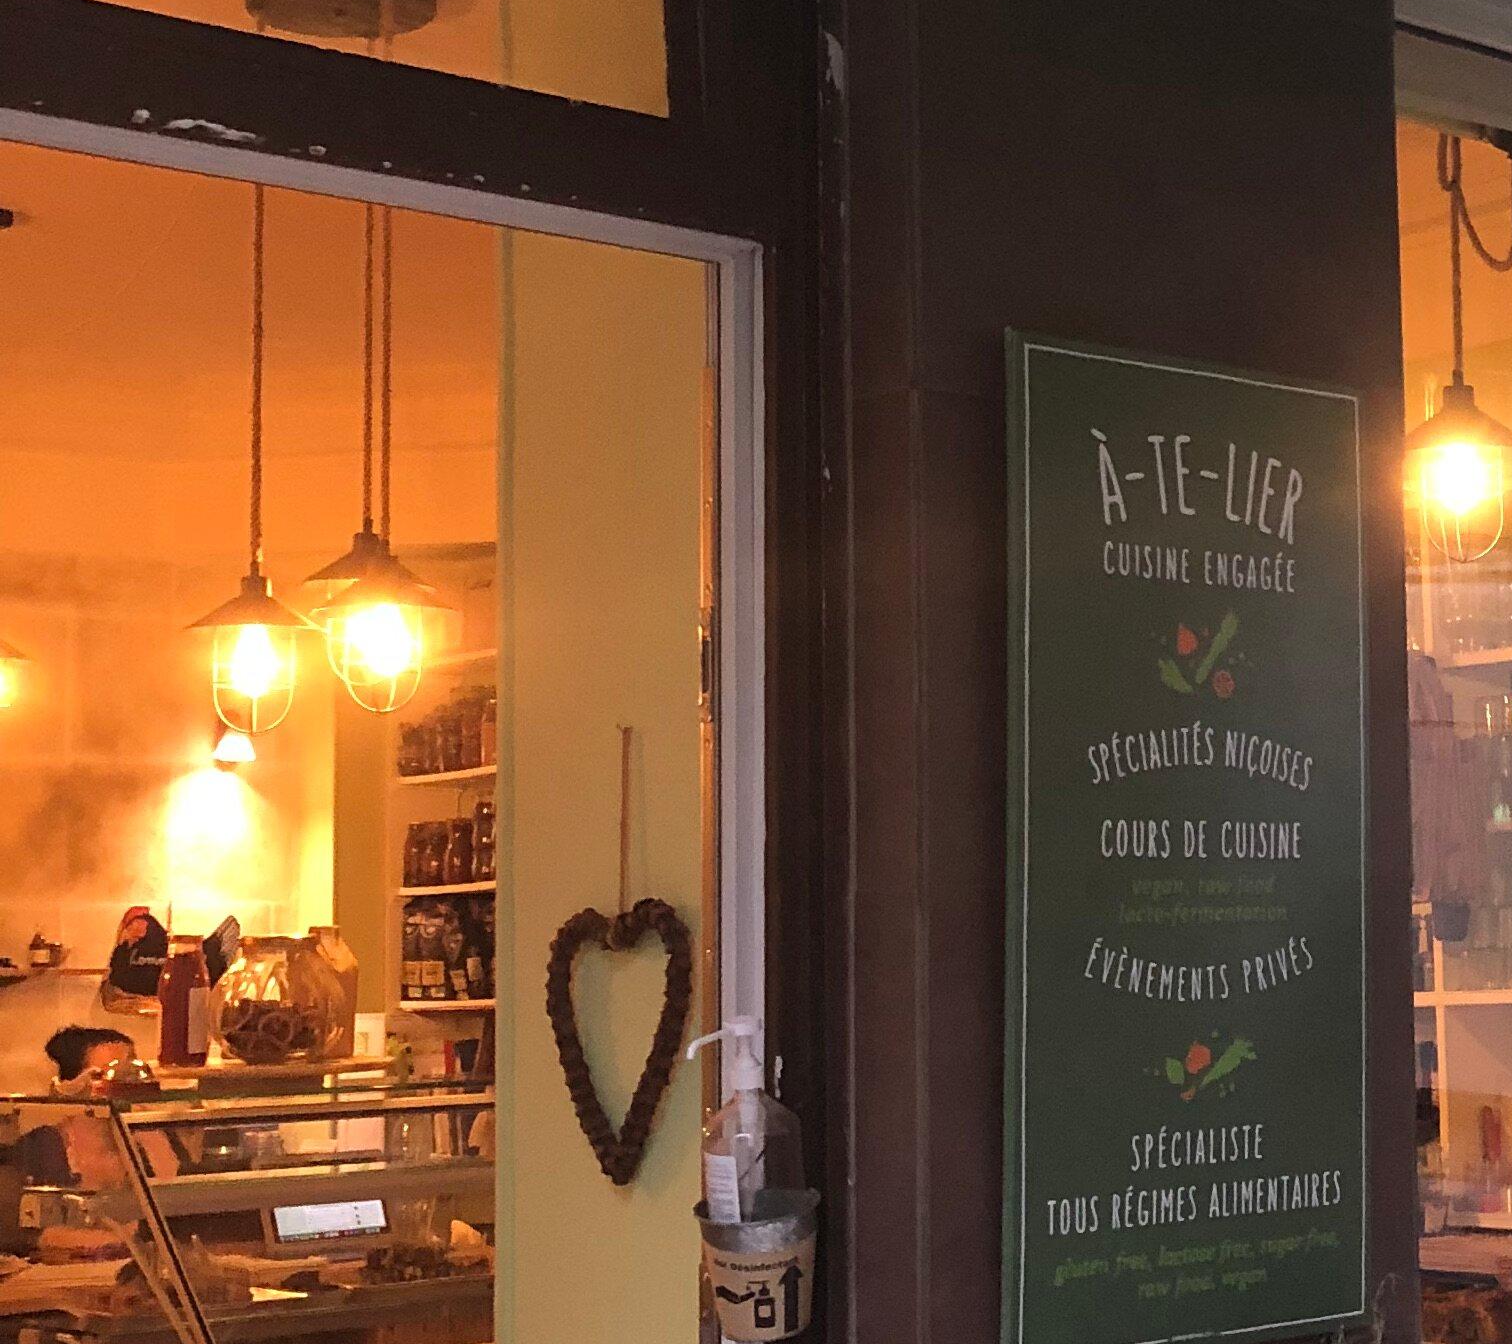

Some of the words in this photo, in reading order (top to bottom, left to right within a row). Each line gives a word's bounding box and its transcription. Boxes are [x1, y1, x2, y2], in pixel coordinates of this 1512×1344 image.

[1090, 428, 1304, 545] À-TE-LIER
[1103, 540, 1191, 584] CUISINE
[1203, 550, 1296, 593] ENGAGÉE
[1087, 720, 1214, 785] SPÉCIALITÉS
[1224, 728, 1314, 792] NIÇOISES
[1101, 818, 1170, 859] COURS
[1183, 819, 1208, 859] DE
[1220, 820, 1302, 860] CUISINE
[1084, 936, 1229, 1002] ÉVÈNEMENTS
[1241, 936, 1314, 994] PRIVÉS
[1130, 1124, 1264, 1172] SPÉCIALISTE
[1047, 1194, 1099, 1236] TOUS
[1110, 1185, 1197, 1231] RÉGIMES
[1208, 1169, 1342, 1219] ALIMENTAIRES
